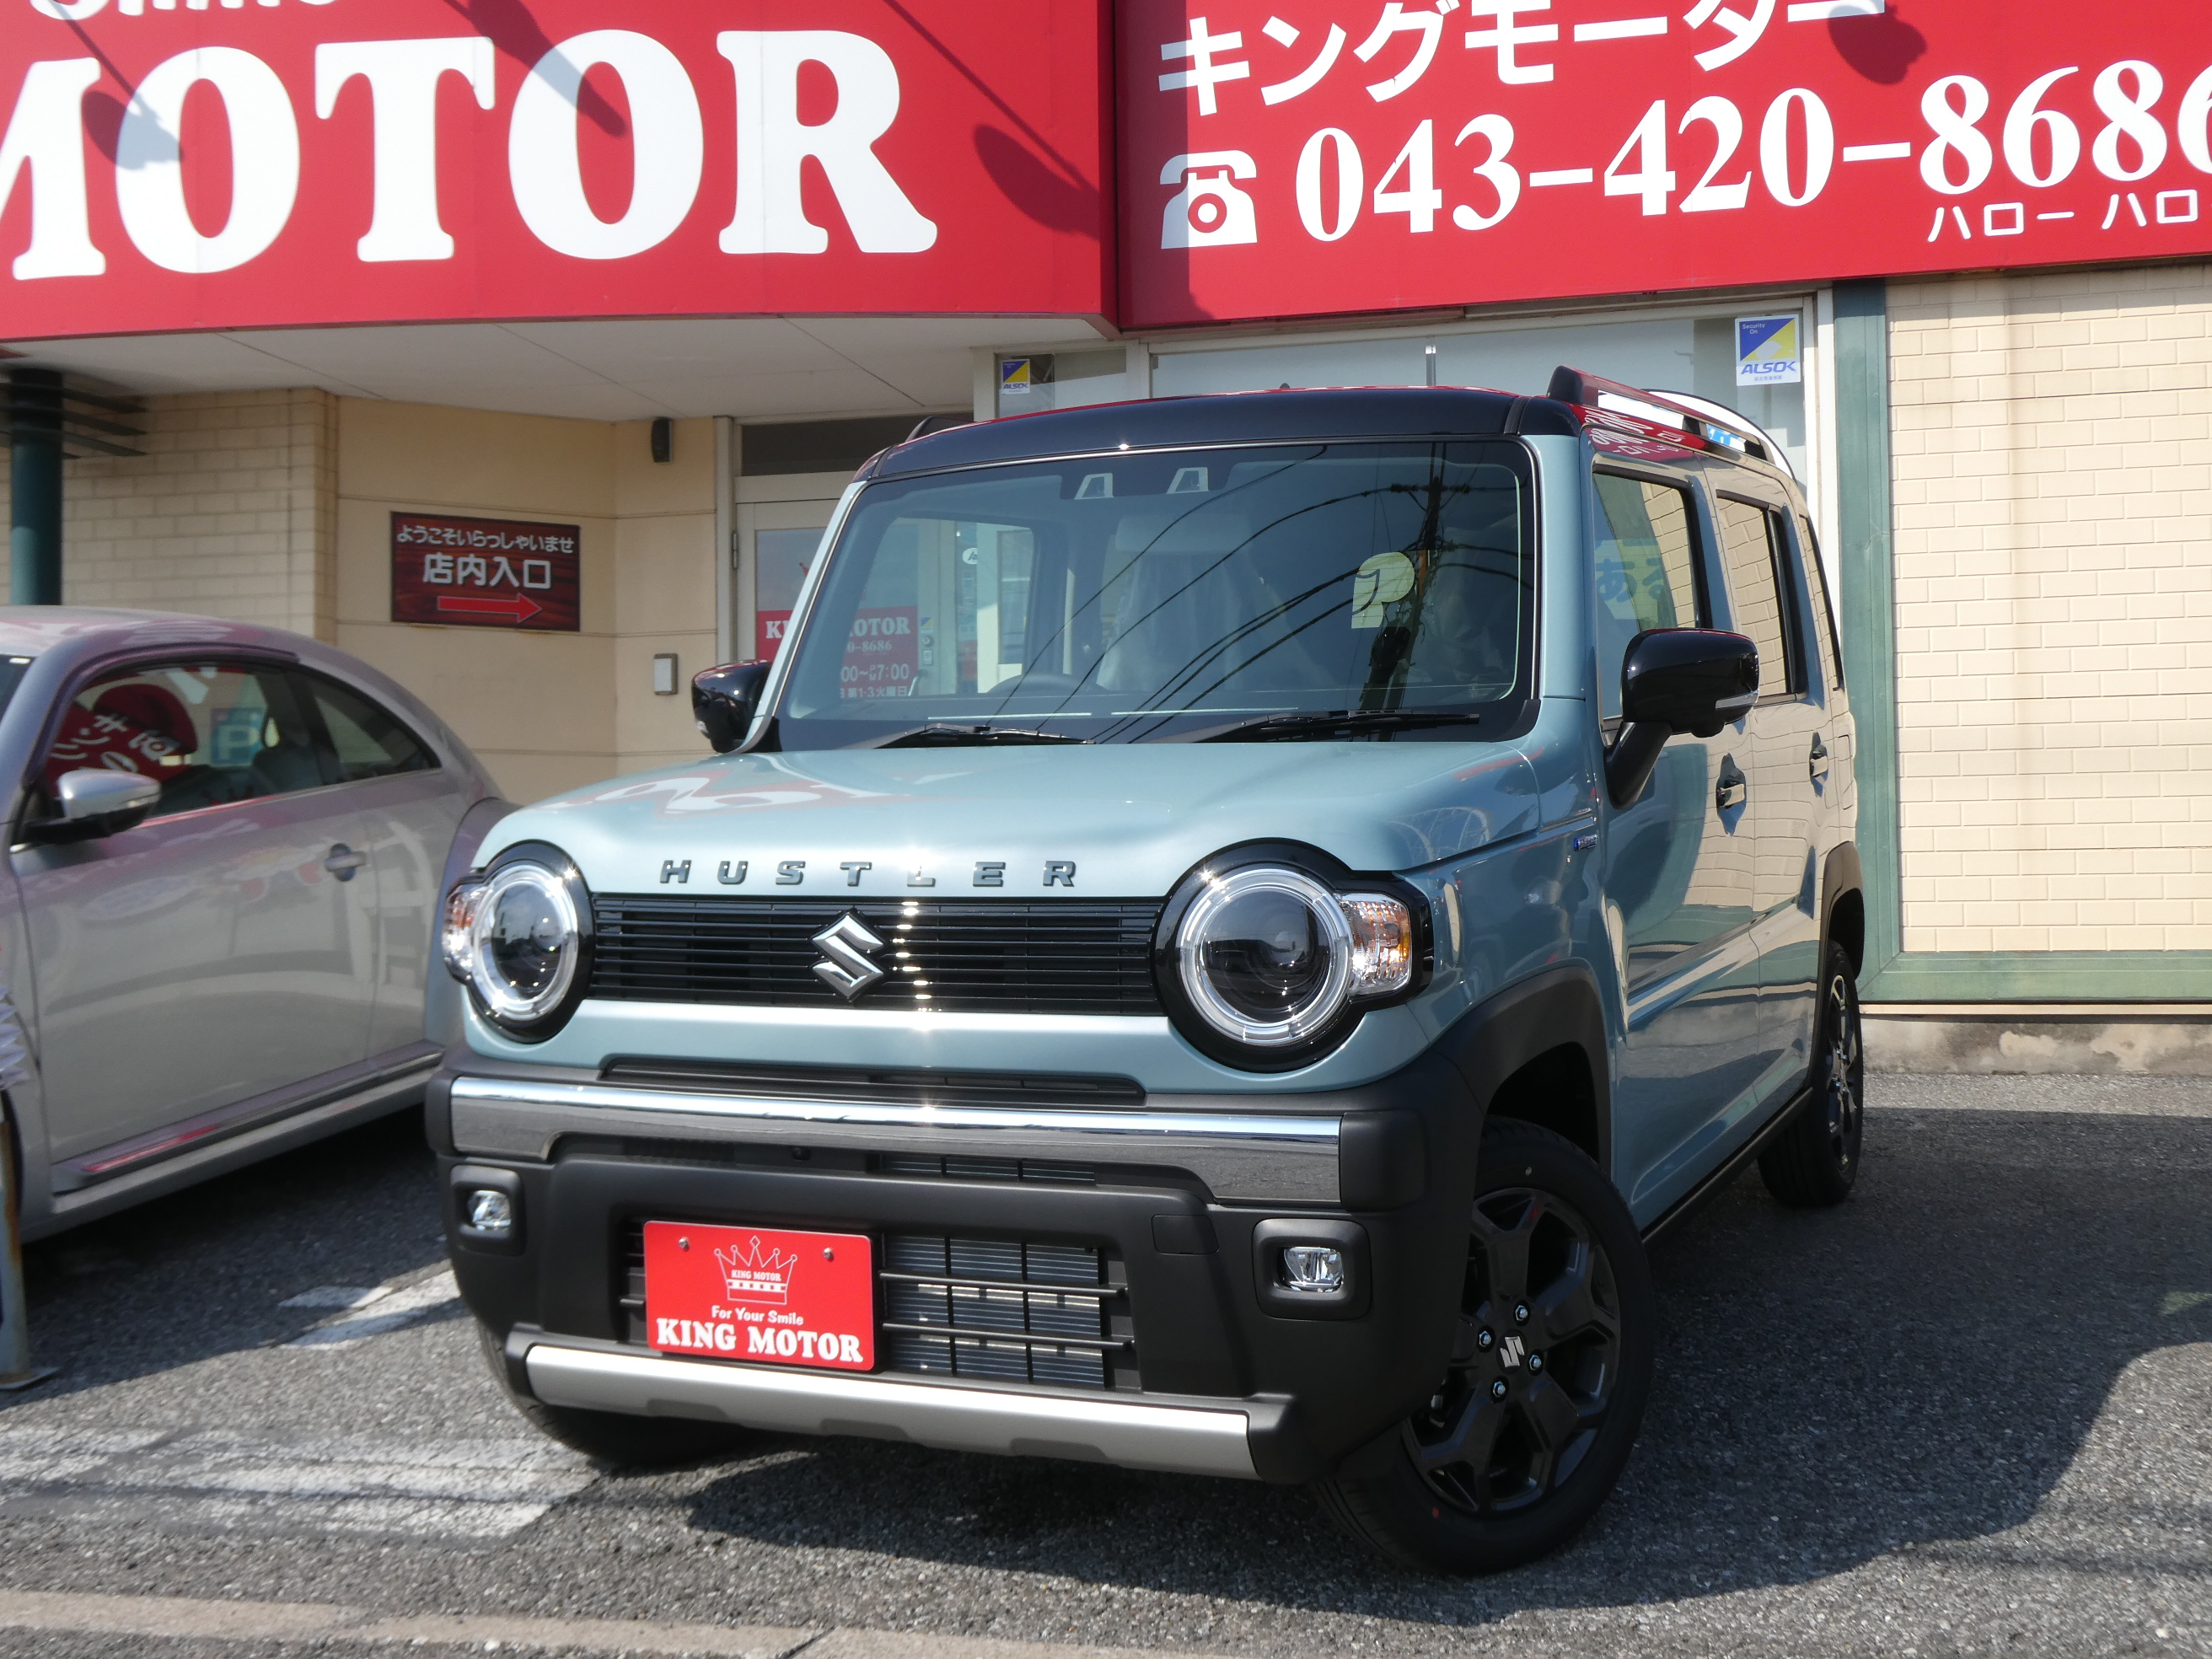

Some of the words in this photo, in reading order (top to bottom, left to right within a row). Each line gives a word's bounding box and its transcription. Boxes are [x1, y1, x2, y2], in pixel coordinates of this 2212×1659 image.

[1159, 0, 1885, 115] キングモーター
[1928, 201, 2075, 242] ハロー
[2102, 189, 2212, 230] ハロ
[1741, 361, 1797, 375] ALSOK
[422, 552, 551, 590] 店内入口
[849, 616, 910, 637] OTOR
[659, 859, 1076, 888] HUSTLER
[731, 1269, 751, 1280] KING
[753, 1271, 781, 1281] MOTOR
[711, 1305, 731, 1319] For
[735, 1307, 765, 1323] Your
[767, 1310, 804, 1326] Smile
[656, 1318, 737, 1350] KING
[747, 1326, 863, 1363] MOTOR
